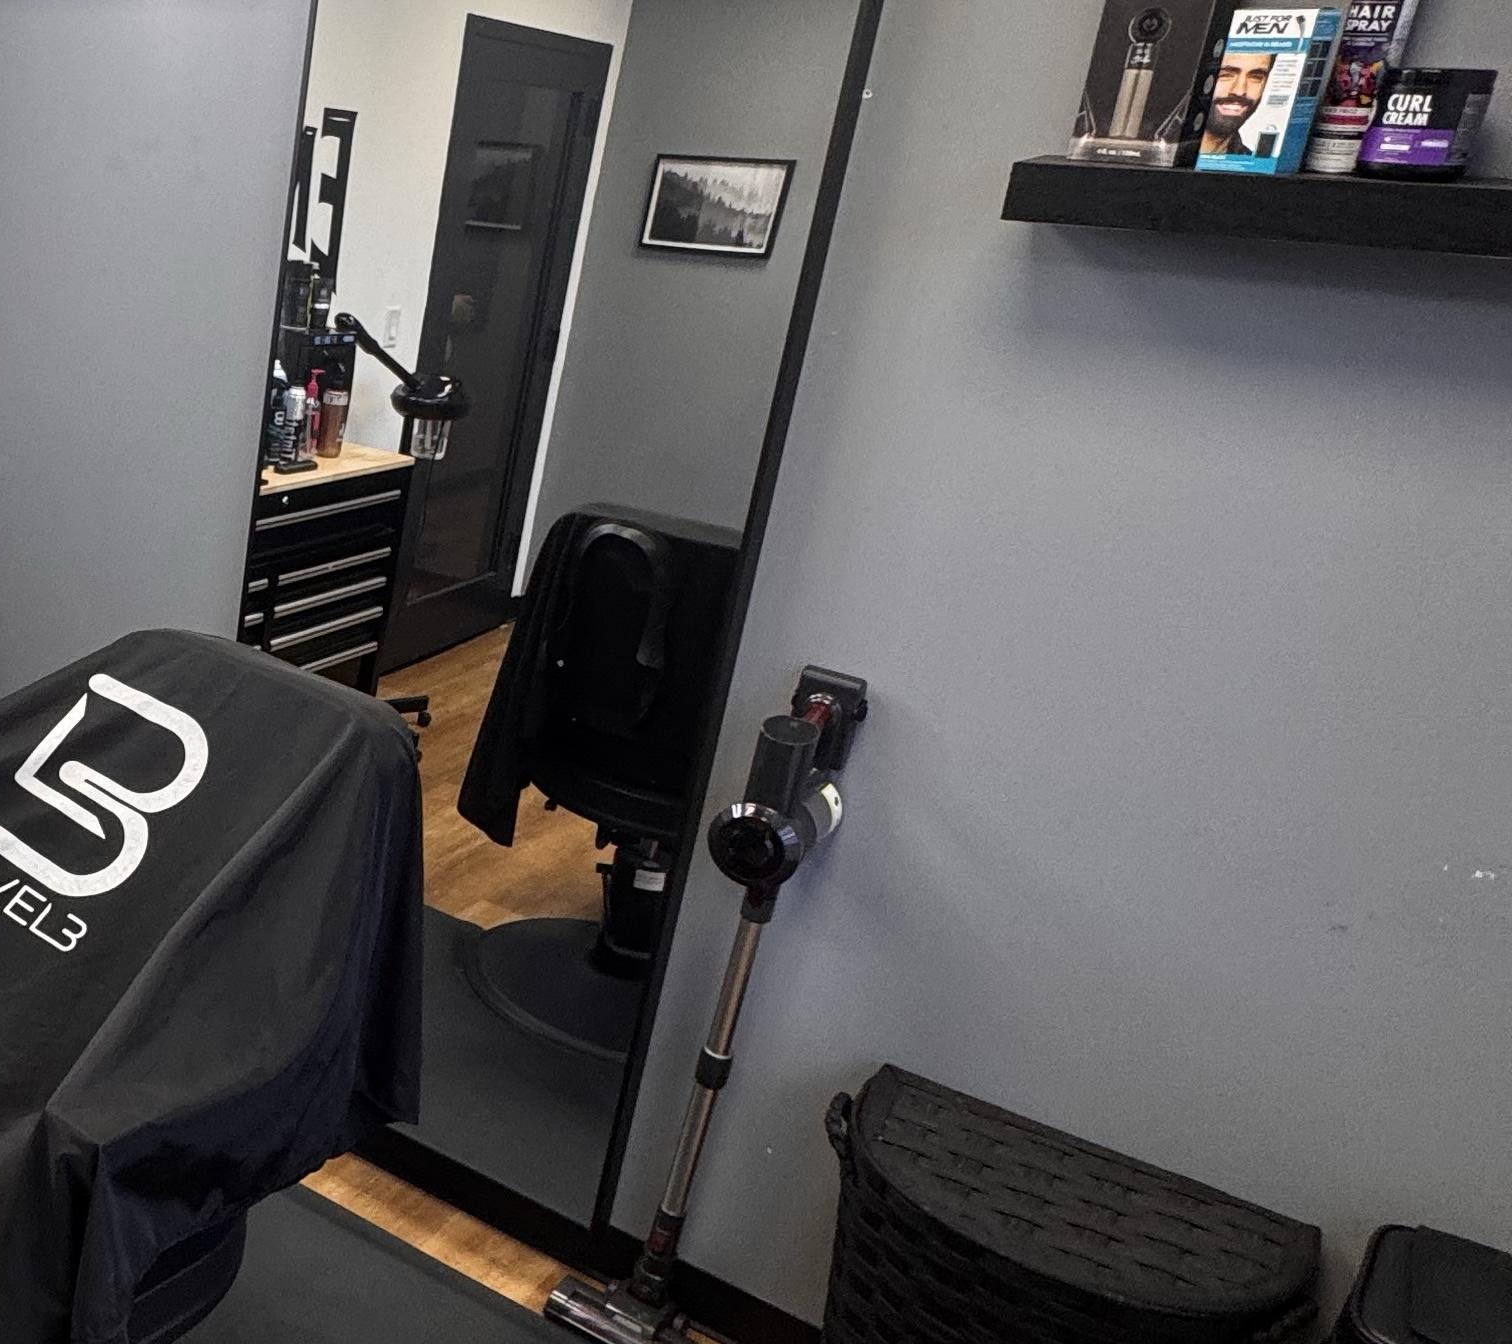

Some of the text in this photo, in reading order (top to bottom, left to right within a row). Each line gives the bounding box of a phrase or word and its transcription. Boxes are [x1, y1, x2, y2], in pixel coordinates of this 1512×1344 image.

[1349, 5, 1396, 19] HAIR
[1245, 15, 1269, 23] JUST
[1345, 19, 1392, 32] SPRAY
[1235, 23, 1289, 35] MEN
[1387, 93, 1433, 112] CURL
[1382, 111, 1429, 126] CREAM
